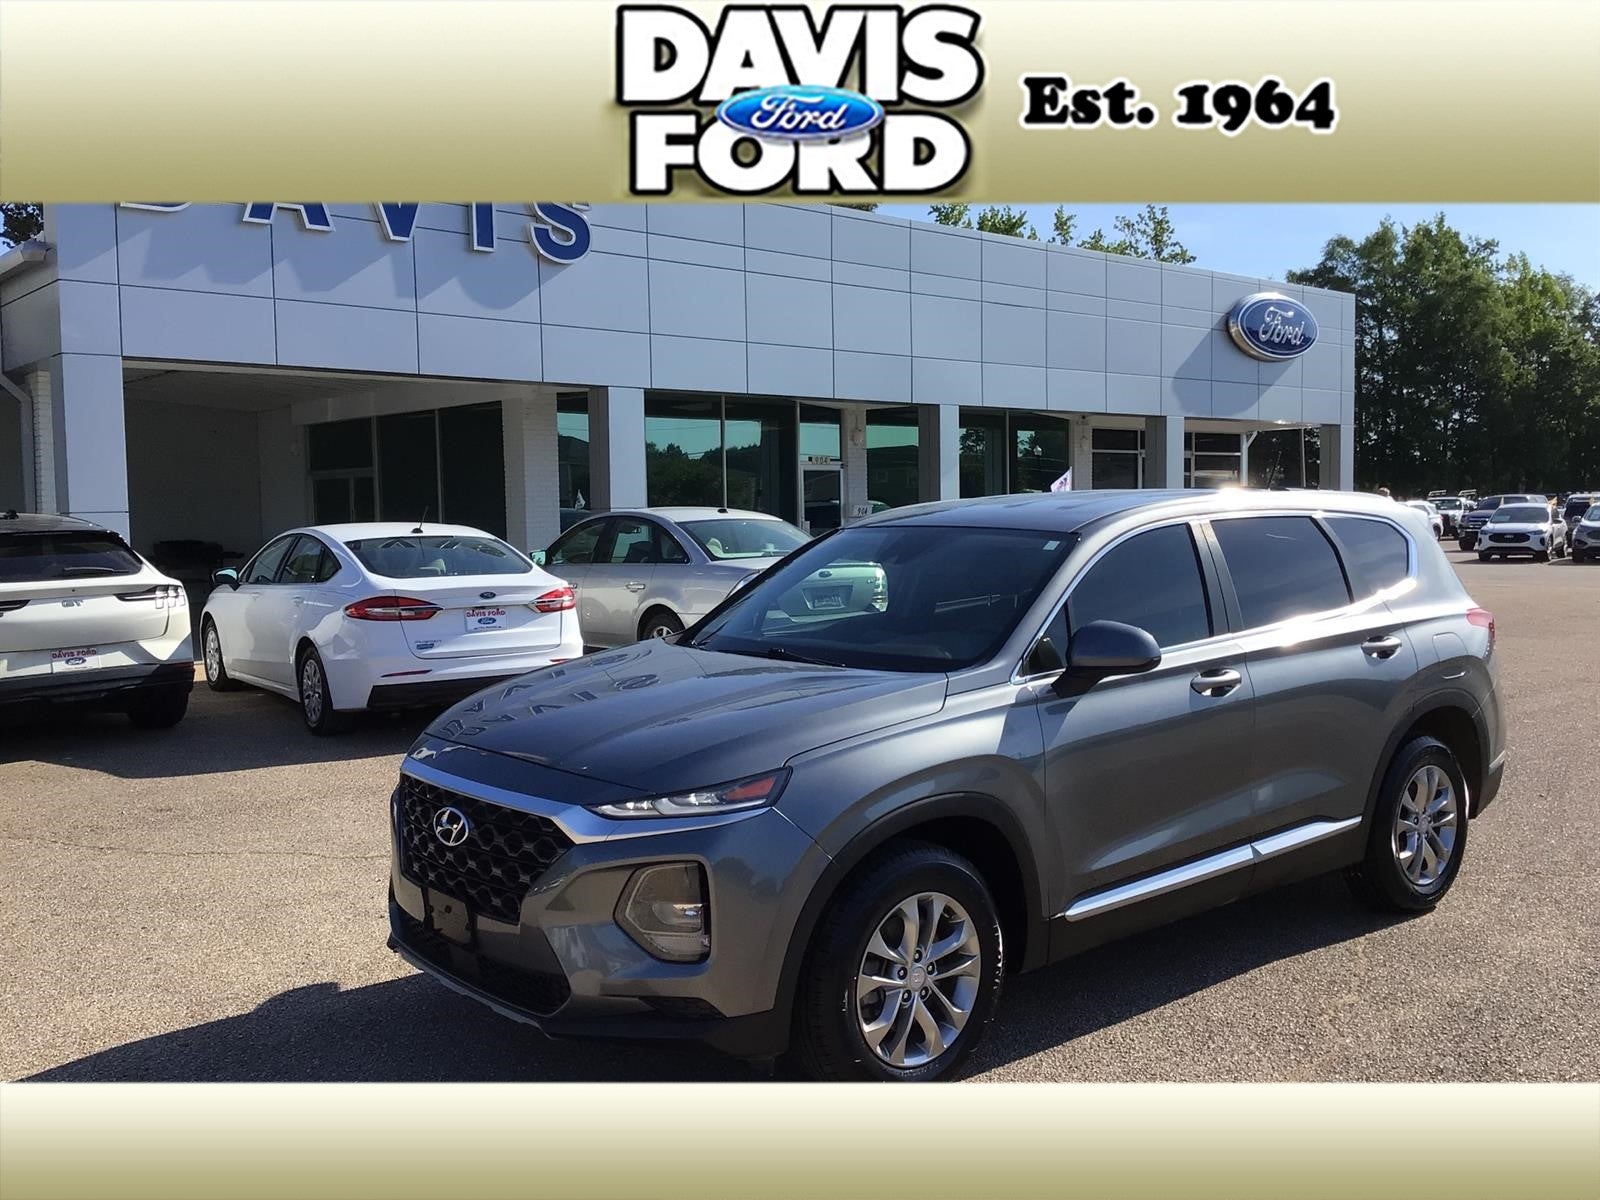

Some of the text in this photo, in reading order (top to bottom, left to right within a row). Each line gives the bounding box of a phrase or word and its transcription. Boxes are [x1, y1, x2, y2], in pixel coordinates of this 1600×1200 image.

[1259, 306, 1305, 346] Ford
[465, 609, 487, 618] DAVIS
[51, 650, 76, 659] DAVIS
